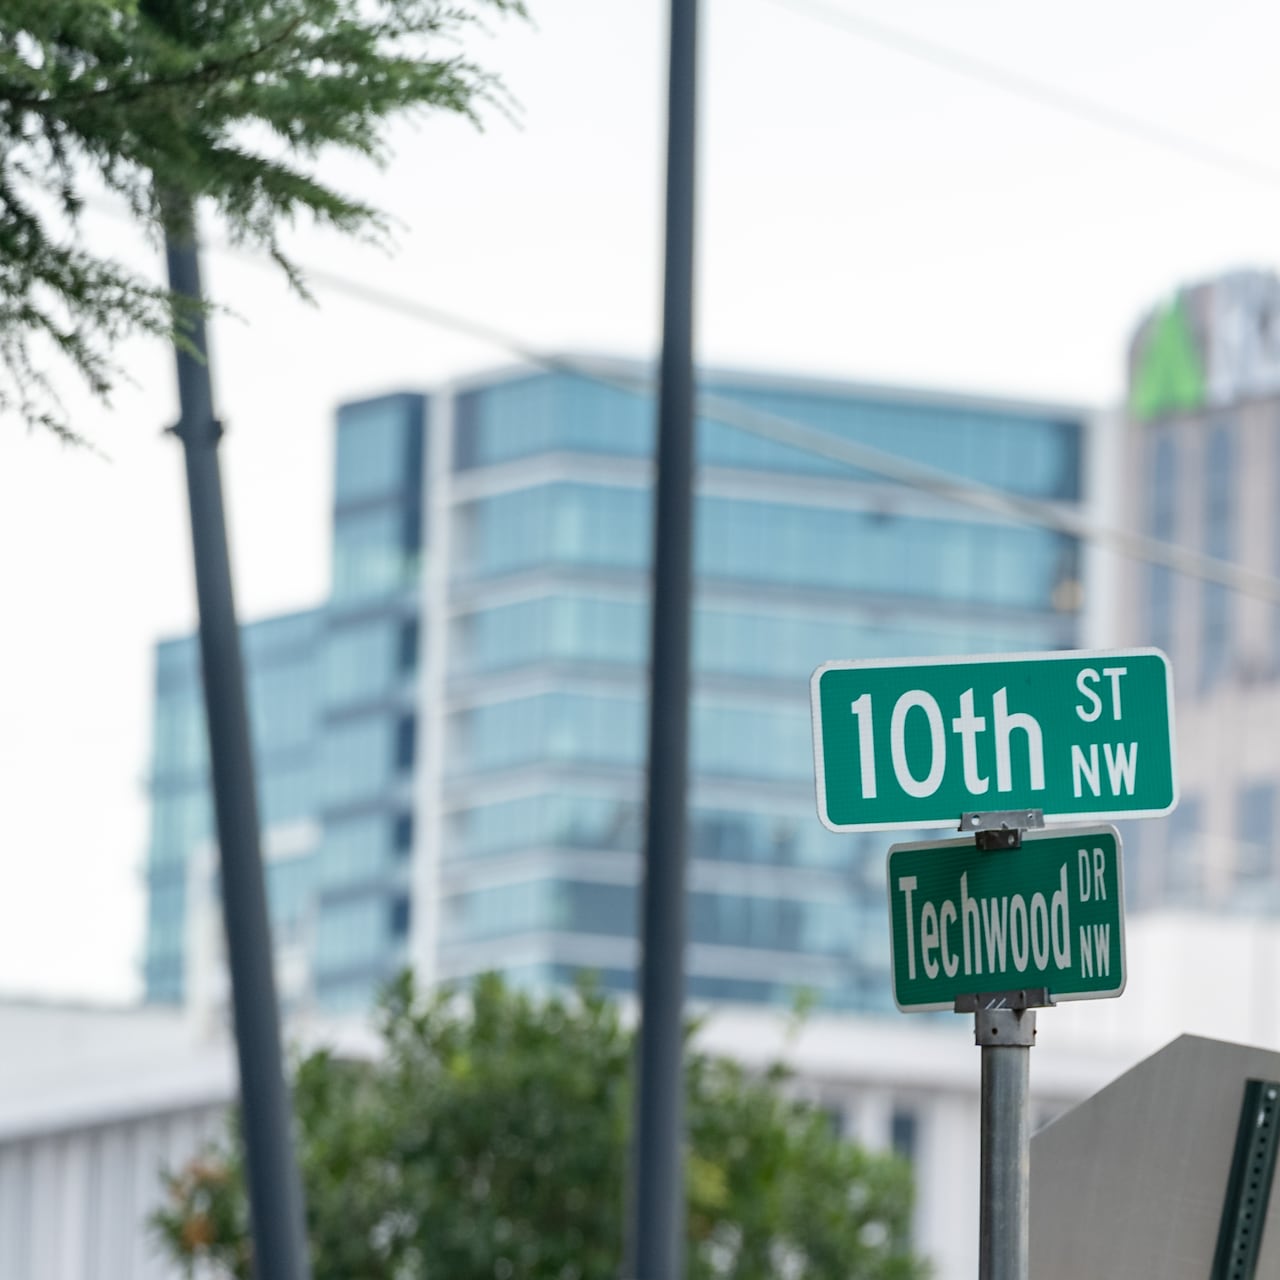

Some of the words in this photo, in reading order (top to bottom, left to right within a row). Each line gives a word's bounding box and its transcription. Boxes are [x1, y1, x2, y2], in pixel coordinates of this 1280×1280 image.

[1075, 667, 1127, 723] ST
[850, 686, 1046, 800] 10th
[1071, 742, 1138, 798] NW
[1078, 847, 1107, 902] DR
[898, 862, 1072, 980] Techwood
[1079, 924, 1110, 979] NW
